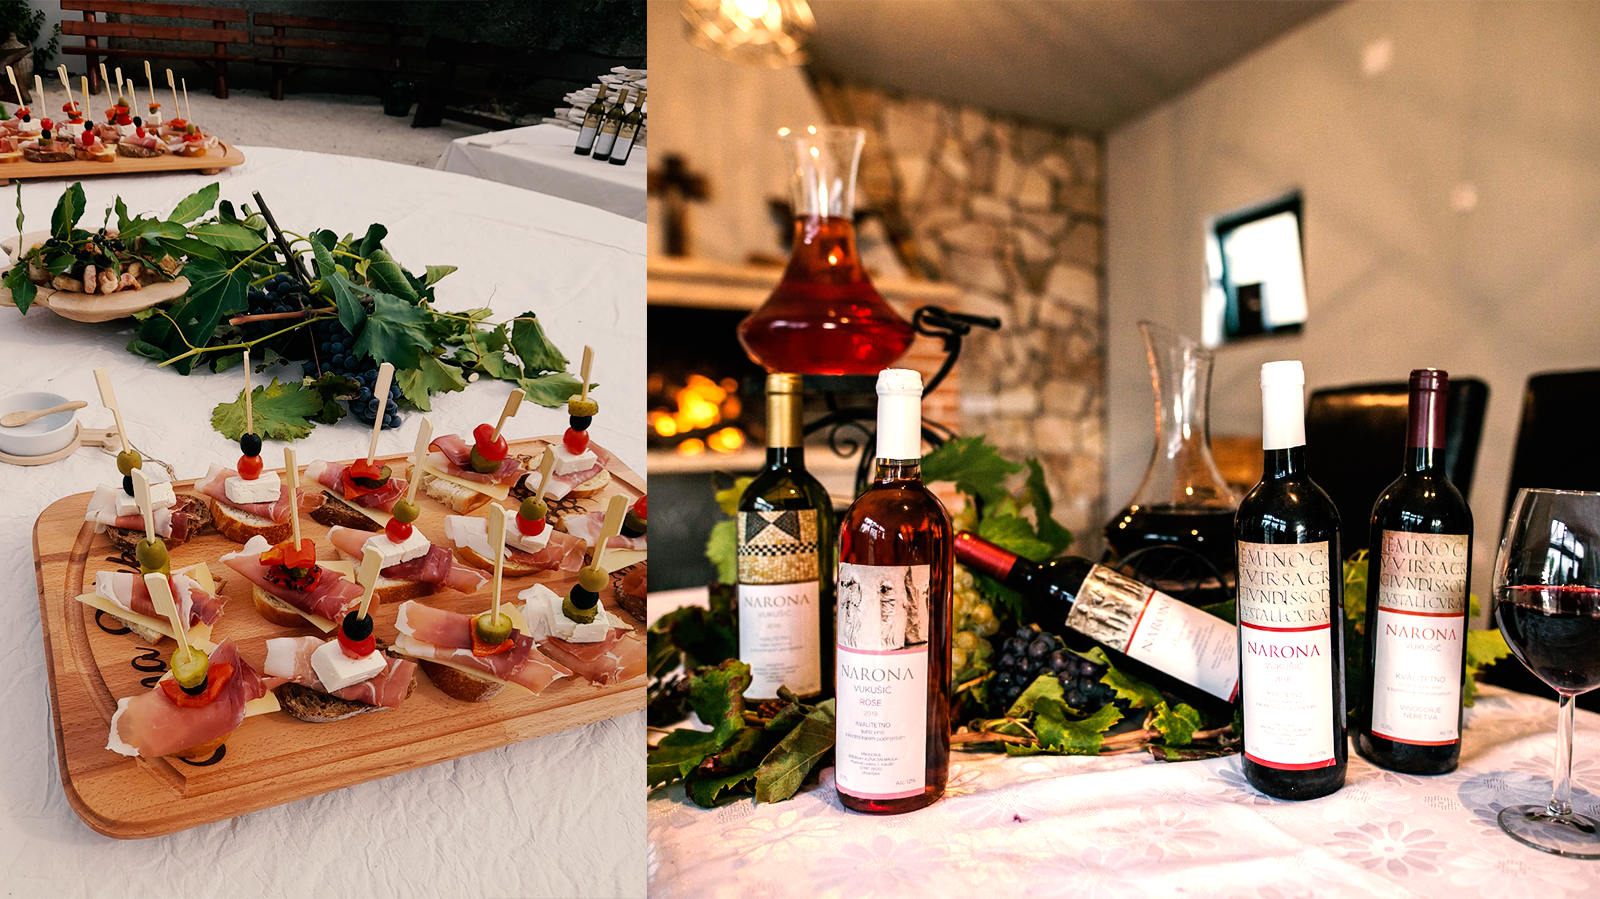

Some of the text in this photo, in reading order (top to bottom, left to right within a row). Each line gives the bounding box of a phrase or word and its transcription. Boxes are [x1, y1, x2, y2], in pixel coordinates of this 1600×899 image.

[744, 594, 810, 608] NARONA
[1385, 623, 1457, 640] NARONA
[1247, 640, 1321, 658] NARONA
[1405, 642, 1442, 652] VUKUŠIĆ
[1264, 661, 1304, 671] VUKUŠIĆ
[841, 663, 914, 682] NARONA
[1395, 672, 1446, 683] KVALITETNO
[853, 684, 892, 695] VUKUŠIĆ
[859, 698, 882, 707] ROSE
[1399, 704, 1442, 713] VINOGORJE
[1403, 712, 1438, 720] NERETVA
